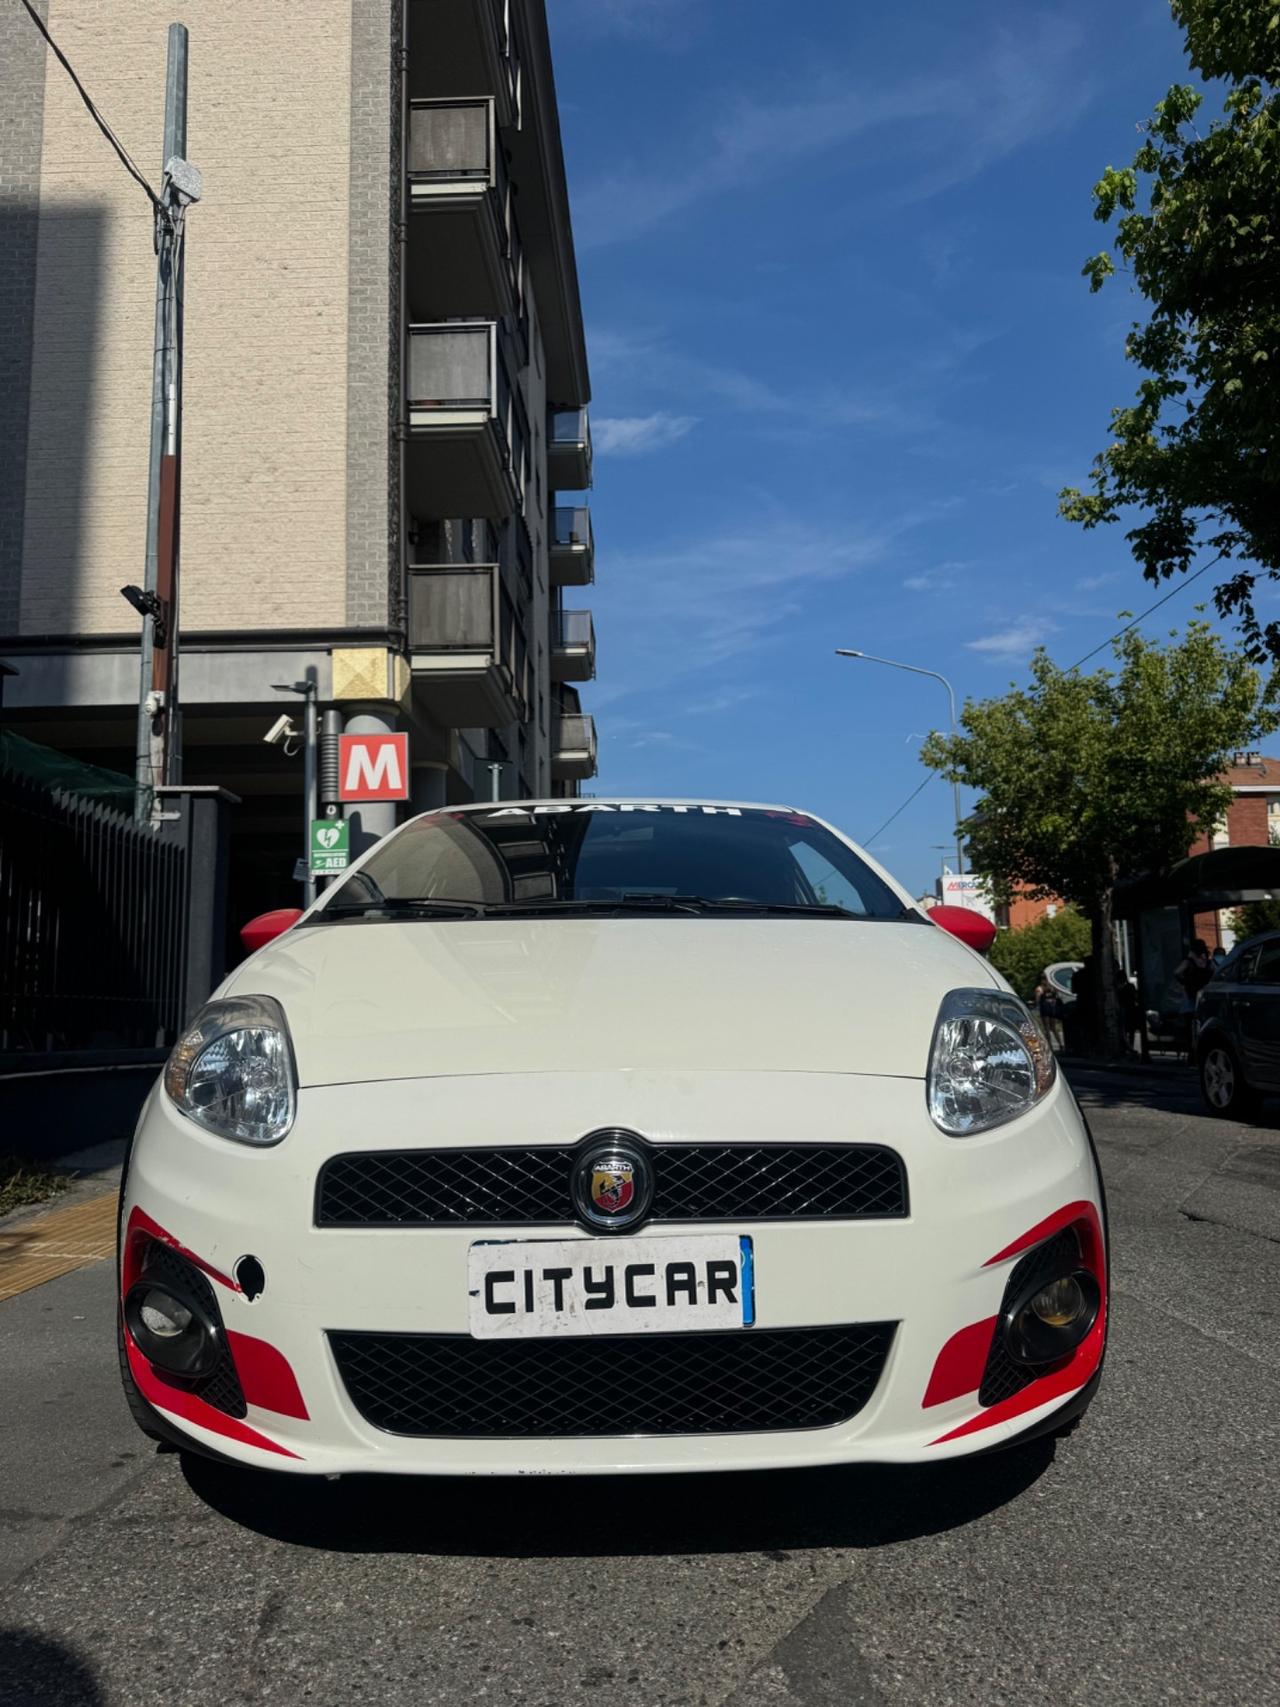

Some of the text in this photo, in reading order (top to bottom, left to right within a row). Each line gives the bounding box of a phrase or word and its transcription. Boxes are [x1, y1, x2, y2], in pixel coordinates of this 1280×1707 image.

[345, 744, 402, 791] M
[487, 804, 742, 817] ABARTH
[325, 857, 347, 868] AED
[594, 1163, 631, 1171] ABARTH
[485, 1260, 738, 1315] CITYCAR
